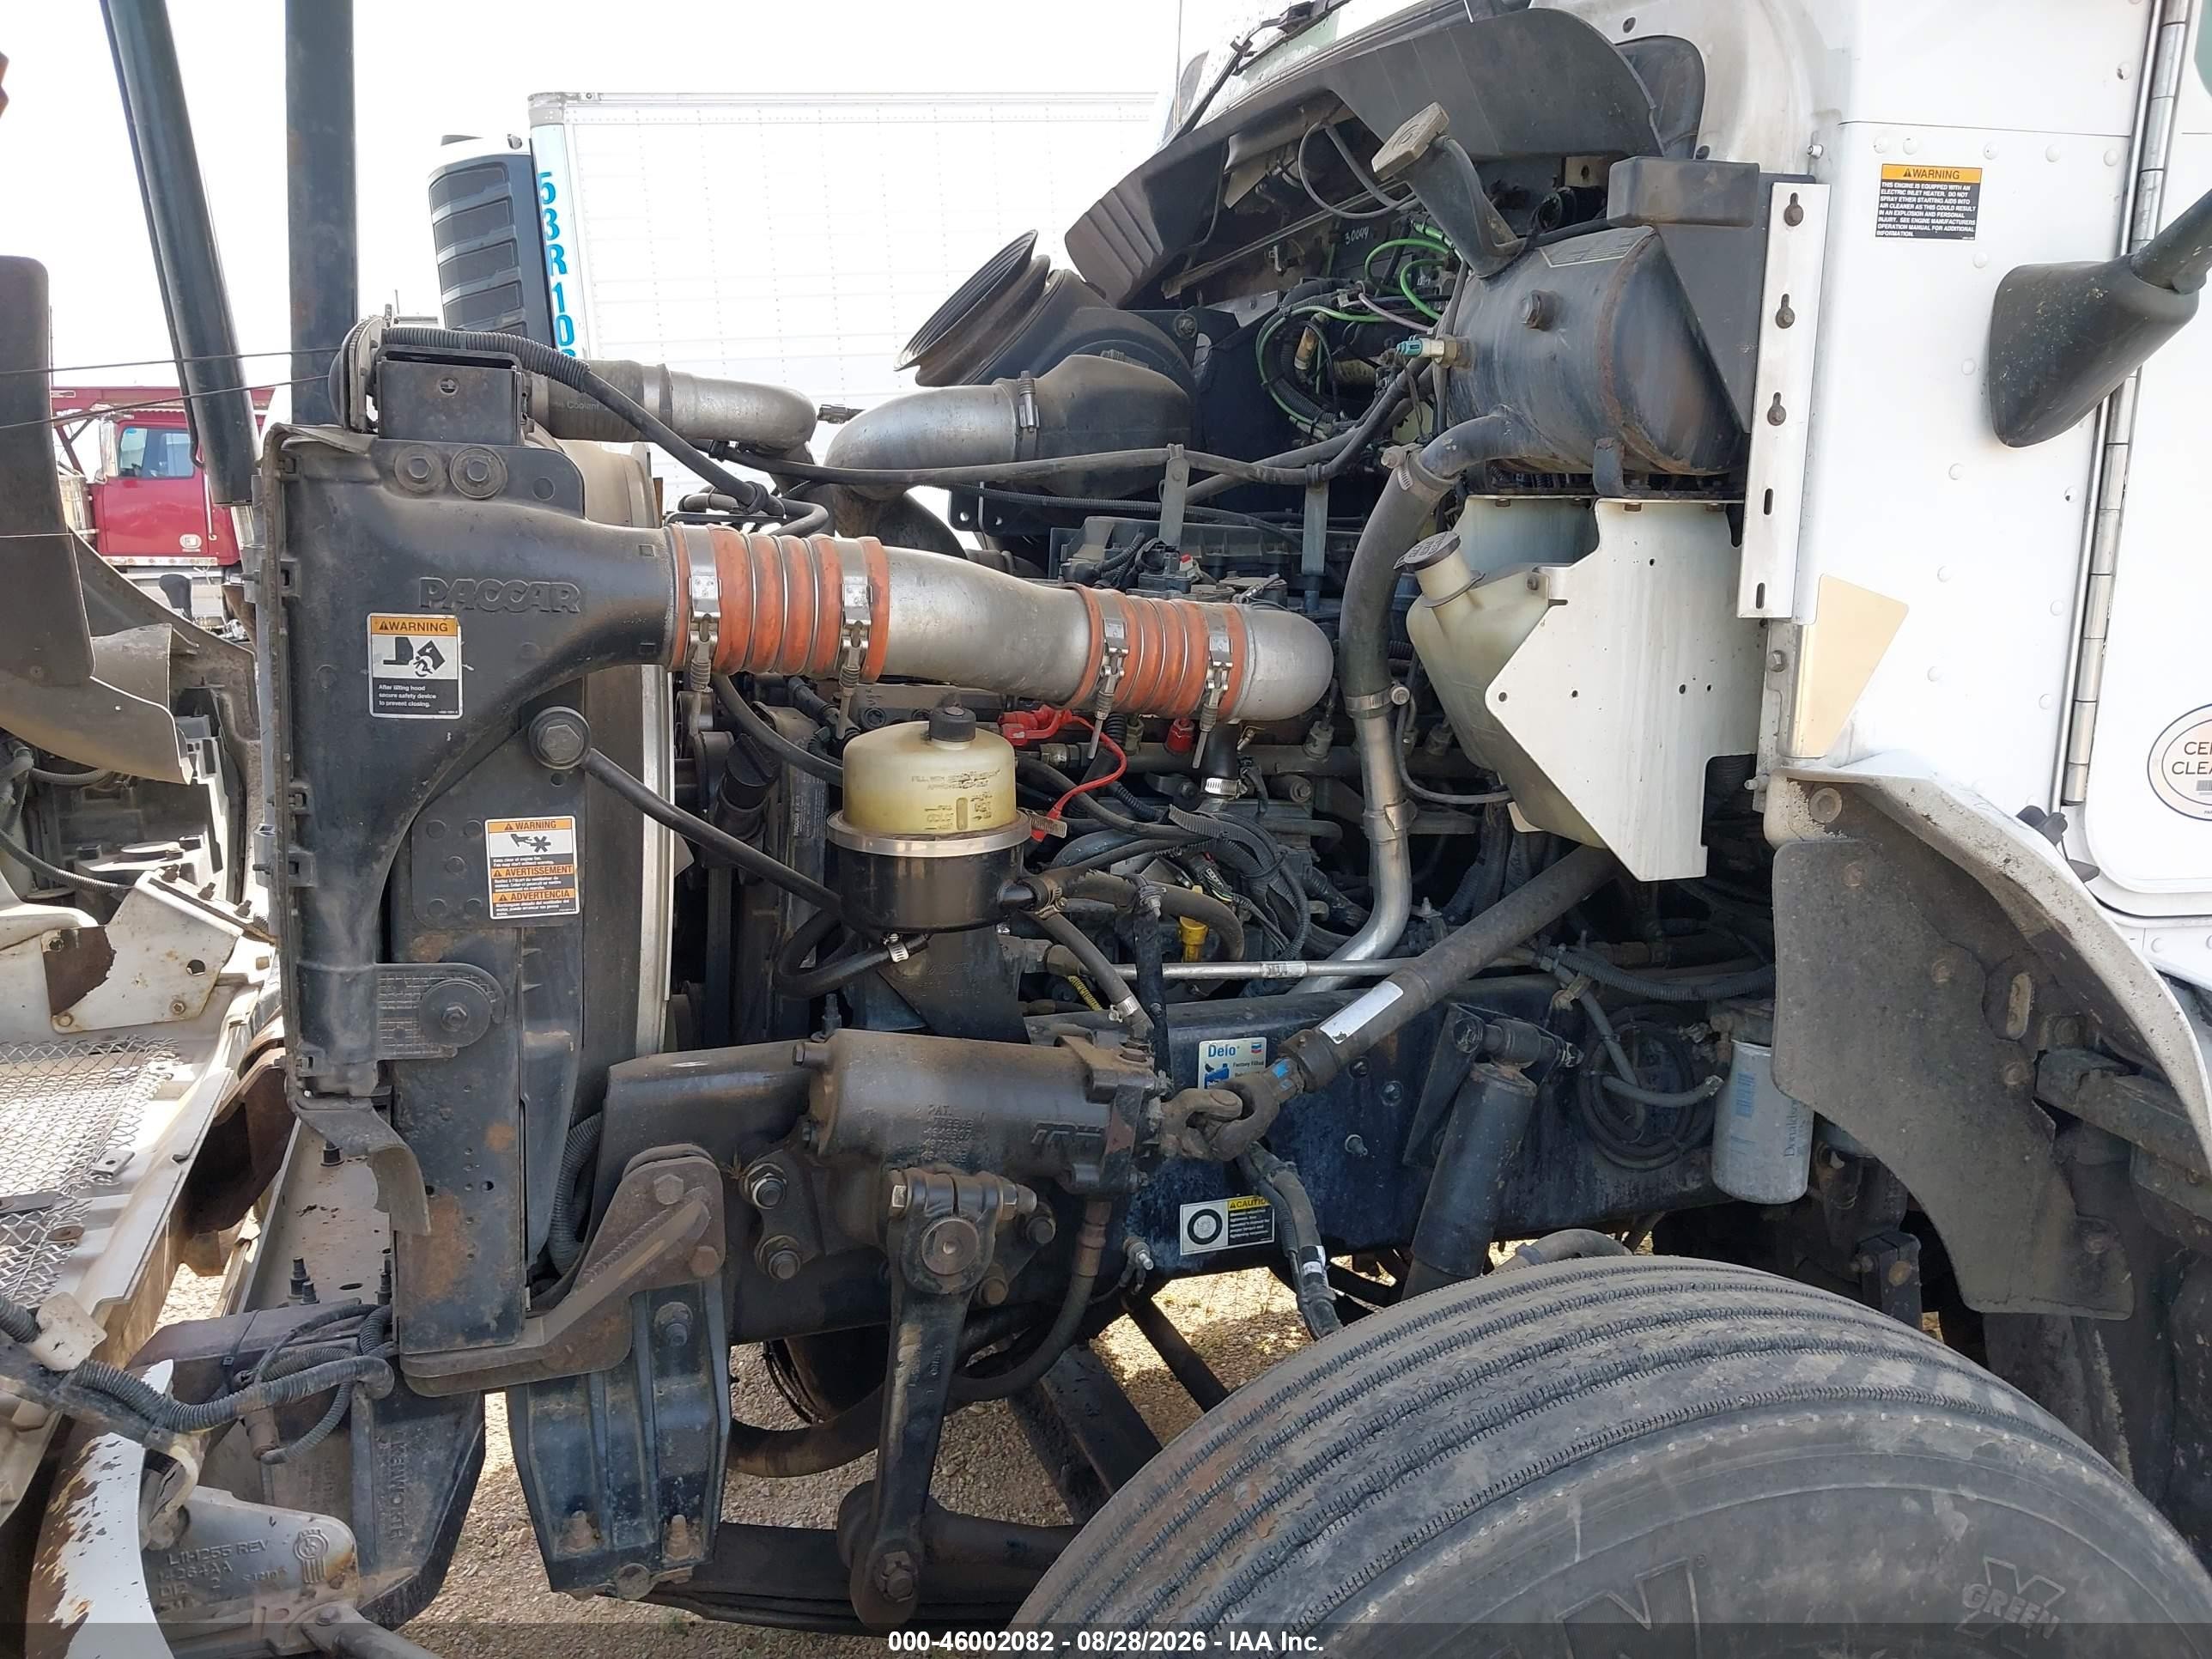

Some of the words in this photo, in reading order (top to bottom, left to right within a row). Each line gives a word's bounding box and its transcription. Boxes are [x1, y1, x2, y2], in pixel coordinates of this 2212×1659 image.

[1912, 169, 1960, 179] WARNING
[538, 172, 577, 358] 53R10
[567, 400, 599, 410] Coolant
[419, 577, 580, 613] PACCAR
[389, 622, 448, 632] WARNING
[2185, 741, 2212, 755] CE
[515, 820, 556, 830] WARNING
[505, 866, 572, 876] AVERTISSEMENT
[511, 890, 570, 901] ADVERTENCIA
[1208, 1043, 1237, 1057] Delo
[237, 1540, 268, 1555] REV
[1962, 1583, 2061, 1640] GREEN
